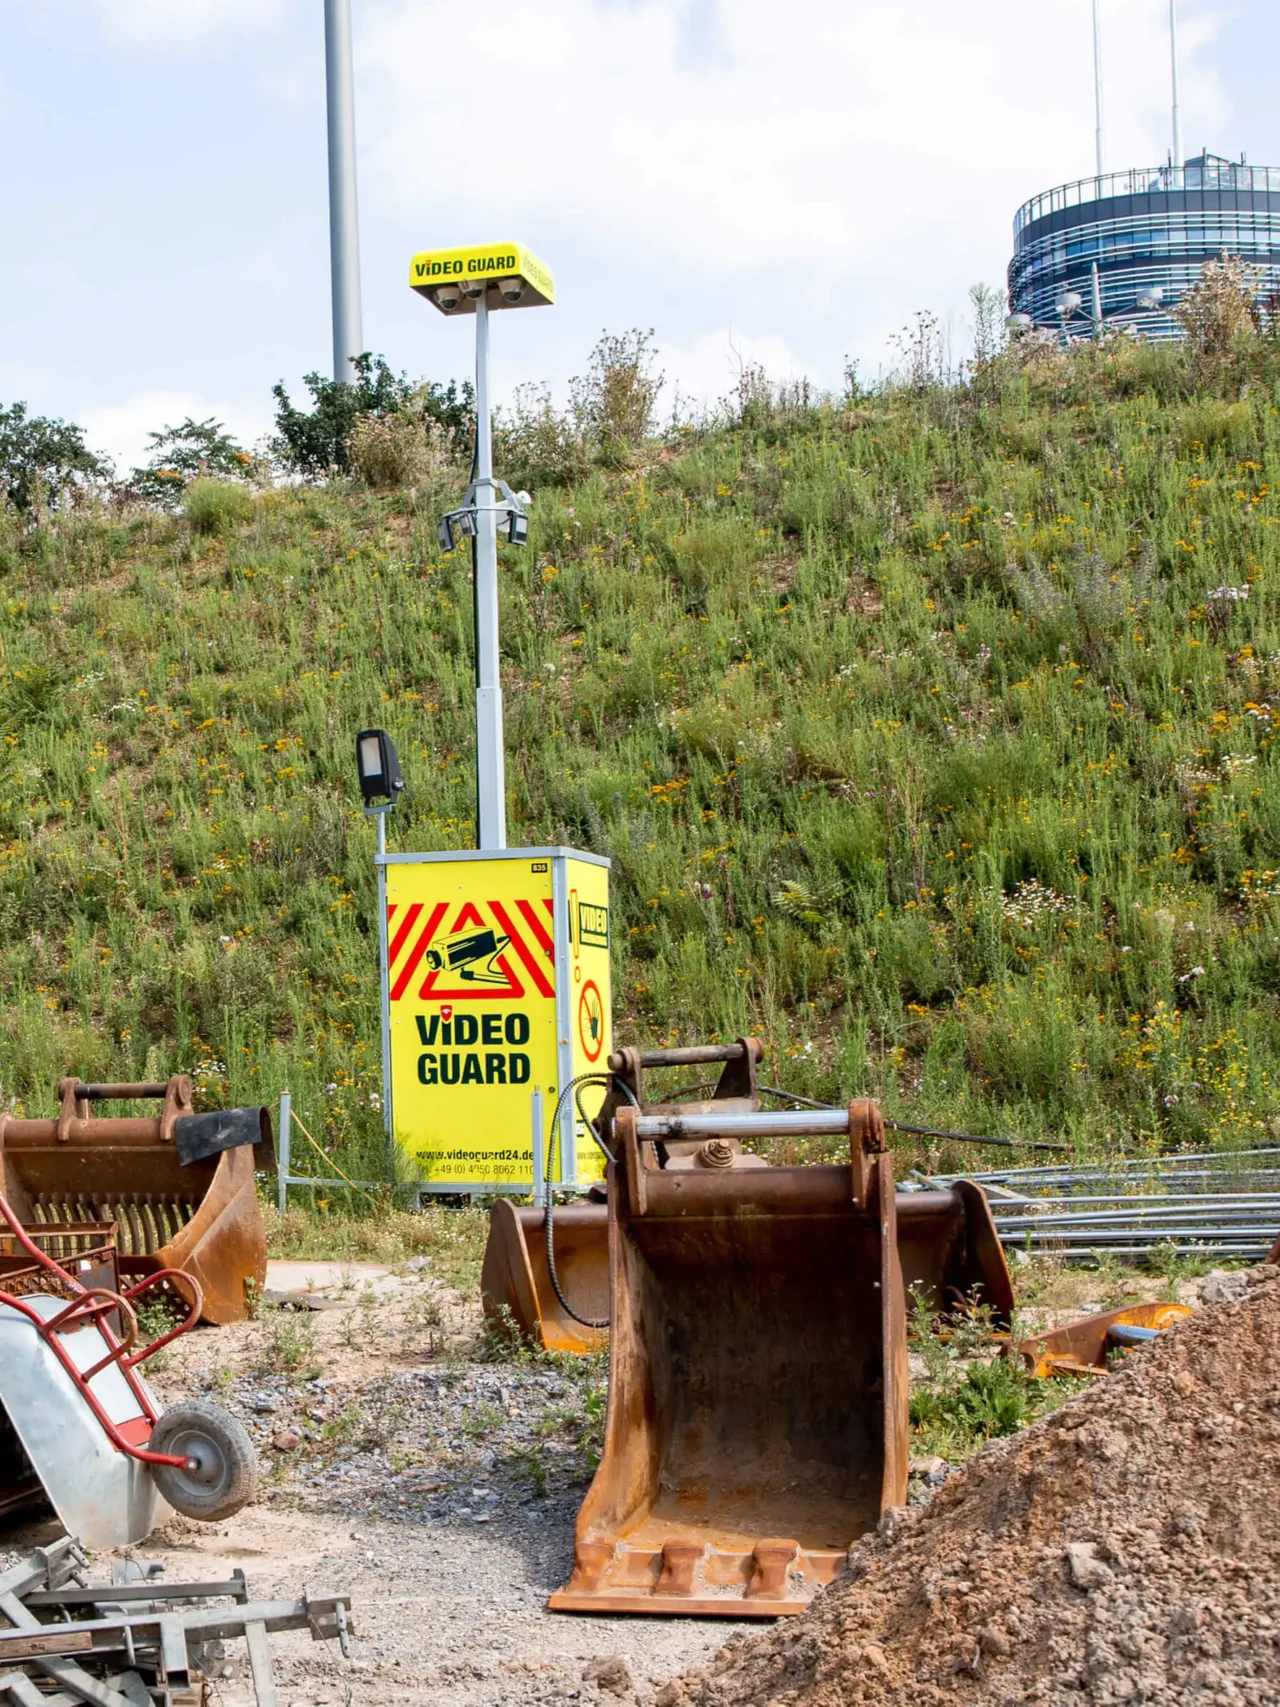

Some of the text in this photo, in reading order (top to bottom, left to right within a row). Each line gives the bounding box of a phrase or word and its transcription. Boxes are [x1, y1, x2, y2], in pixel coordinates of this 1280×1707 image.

[467, 255, 516, 273] GUARD
[418, 1053, 530, 1084] GUARD
[434, 1164, 452, 1174] +49
[454, 1164, 466, 1175] (0)
[493, 1164, 516, 1175] 8062
